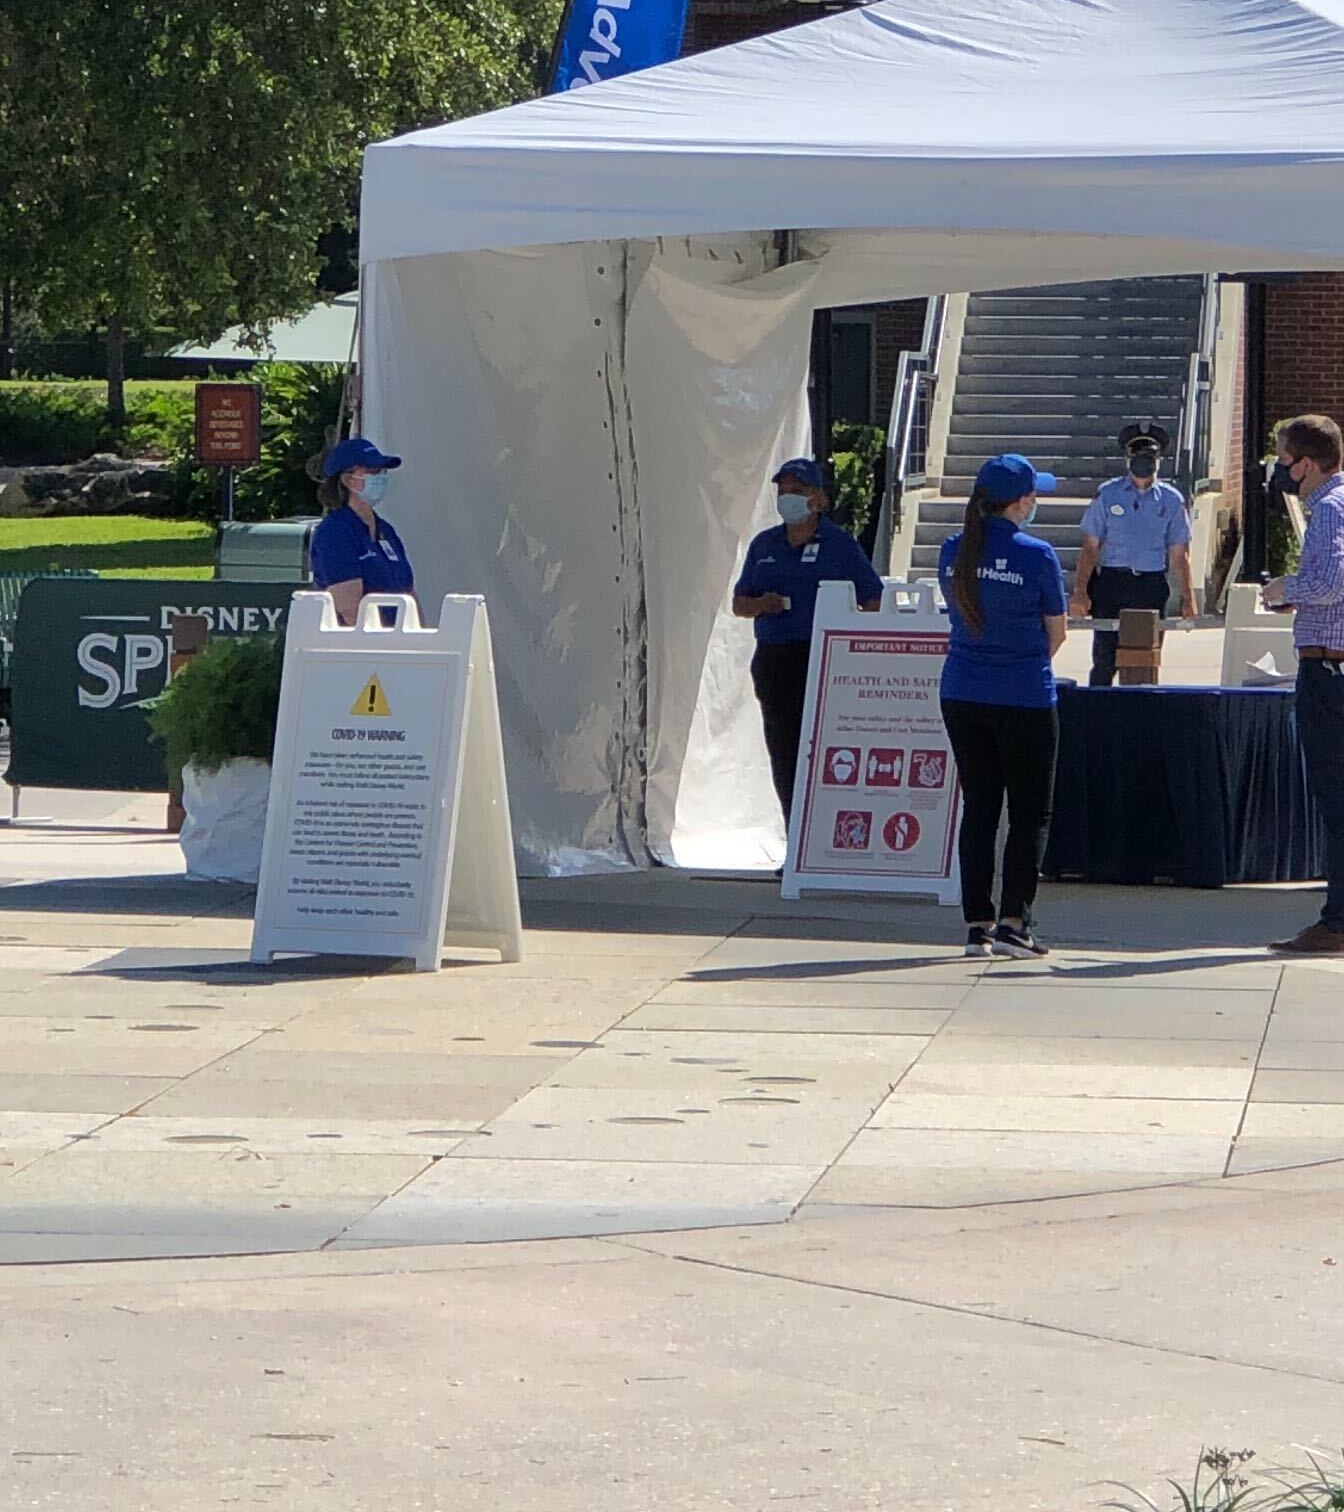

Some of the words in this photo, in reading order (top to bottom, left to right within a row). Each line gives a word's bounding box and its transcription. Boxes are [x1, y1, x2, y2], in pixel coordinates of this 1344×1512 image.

[854, 642, 906, 651] IMPORTANT
[910, 643, 944, 651] NOTICE
[833, 675, 880, 685] HEALTH
[885, 676, 909, 686] AND
[858, 690, 929, 700] REMINDERS
[331, 729, 367, 741] COVID-19
[368, 730, 406, 742] WARNING
